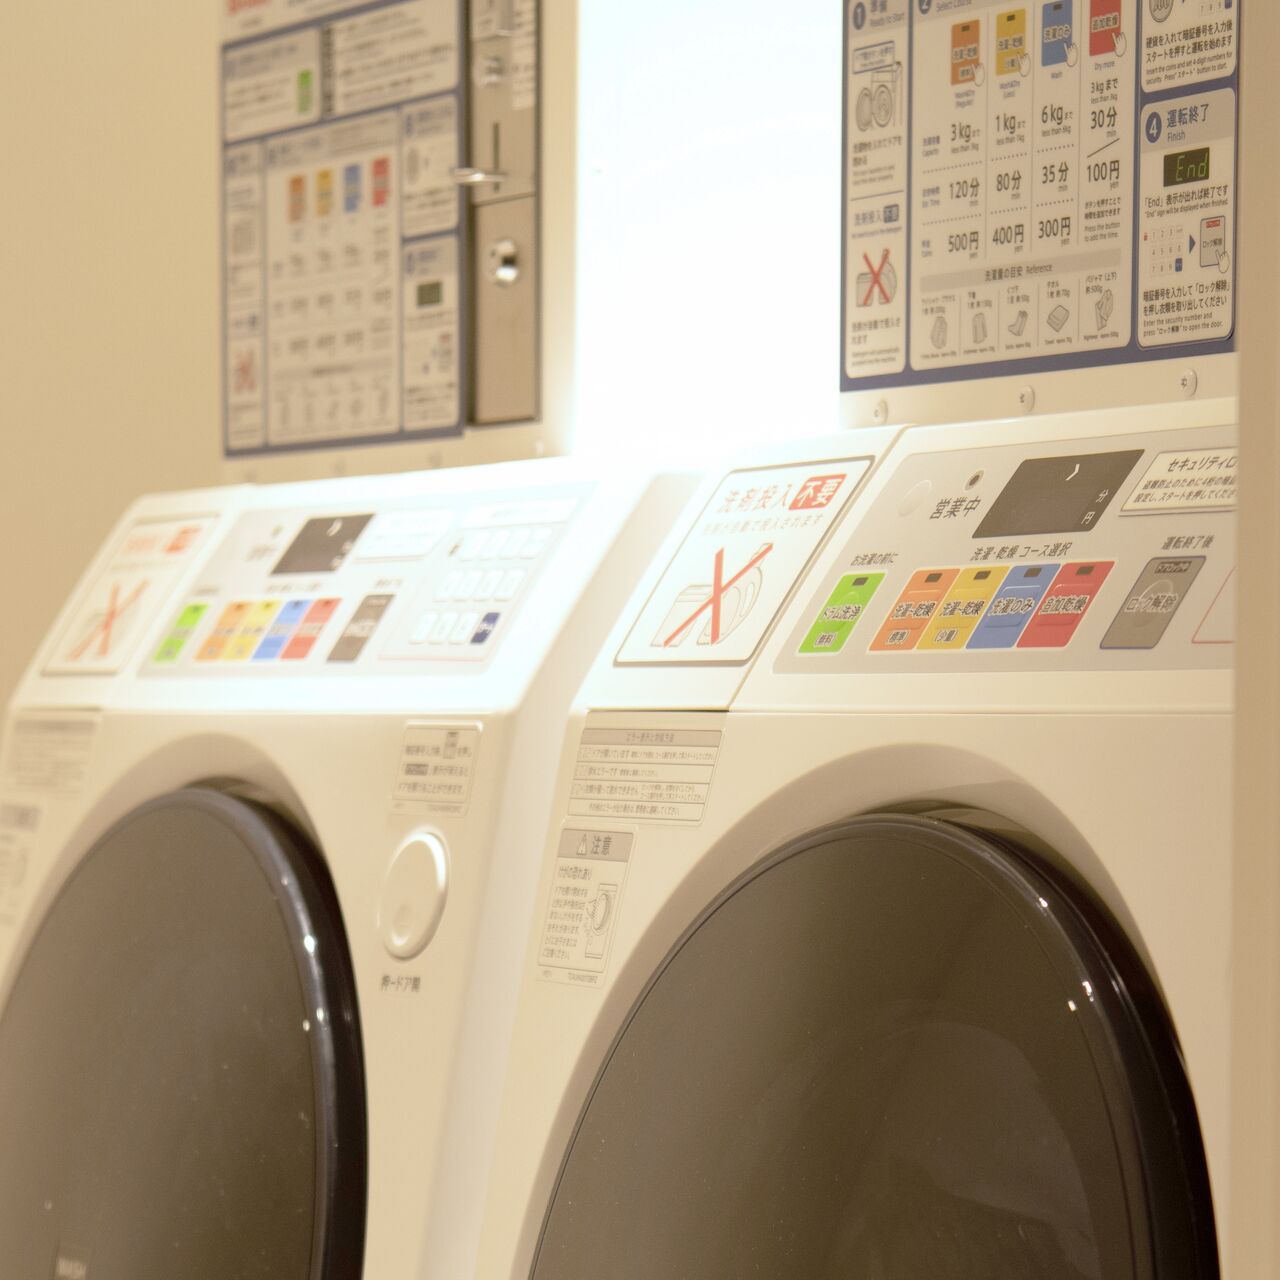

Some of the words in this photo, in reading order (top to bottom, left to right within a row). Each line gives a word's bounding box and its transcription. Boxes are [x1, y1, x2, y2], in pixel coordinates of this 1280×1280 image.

[1090, 105, 1118, 129] 30分
[1167, 104, 1209, 128] 運転終了
[1167, 131, 1186, 142] Finish
[1042, 161, 1069, 184] 35分
[1087, 159, 1120, 183] 100円
[1175, 152, 1209, 182] End
[949, 177, 980, 199] 120分
[996, 170, 1022, 192] 80分
[992, 223, 1024, 245] 400円
[1038, 216, 1071, 239] 300円
[948, 231, 979, 253] 500円
[796, 478, 842, 507] 不要
[1095, 489, 1109, 503] 分
[929, 496, 981, 520] 営業中
[1081, 511, 1095, 524] 円
[1161, 534, 1215, 551] 運転終了後
[990, 598, 1034, 615] 洗濯のみ
[1040, 596, 1088, 613] 追加乾燥
[591, 835, 613, 856] 注意
